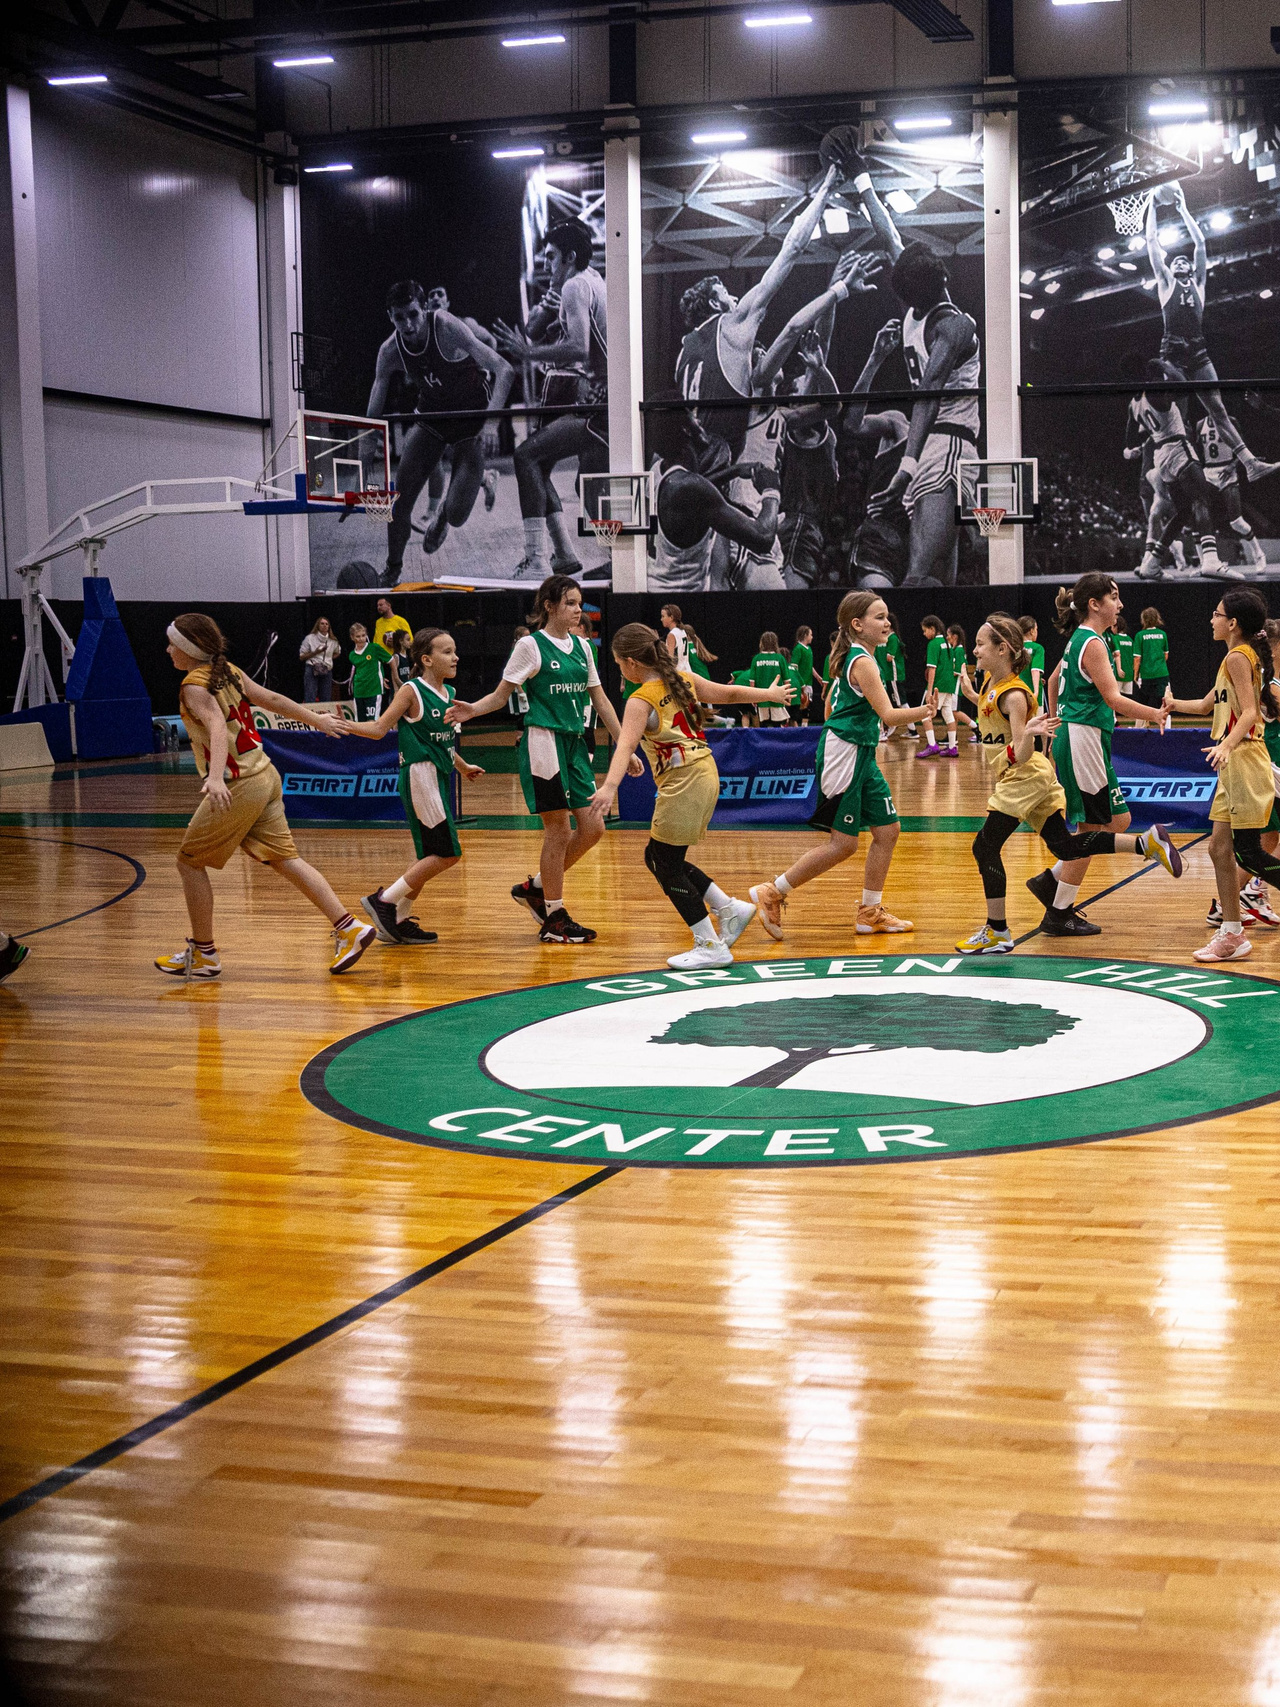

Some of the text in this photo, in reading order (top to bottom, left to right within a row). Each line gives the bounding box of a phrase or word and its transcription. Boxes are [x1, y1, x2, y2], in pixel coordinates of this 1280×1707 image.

[1179, 293, 1195, 307] 14
[424, 372, 442, 388] 14
[1209, 443, 1219, 458] 8
[366, 706, 376, 717] 30
[759, 768, 815, 776] www.start-line.ru
[285, 778, 401, 793] START LIN
[755, 780, 809, 795] LINE
[1118, 782, 1213, 798] START
[585, 958, 1279, 1009] GREEN HILL
[428, 1107, 949, 1157] CENTER
